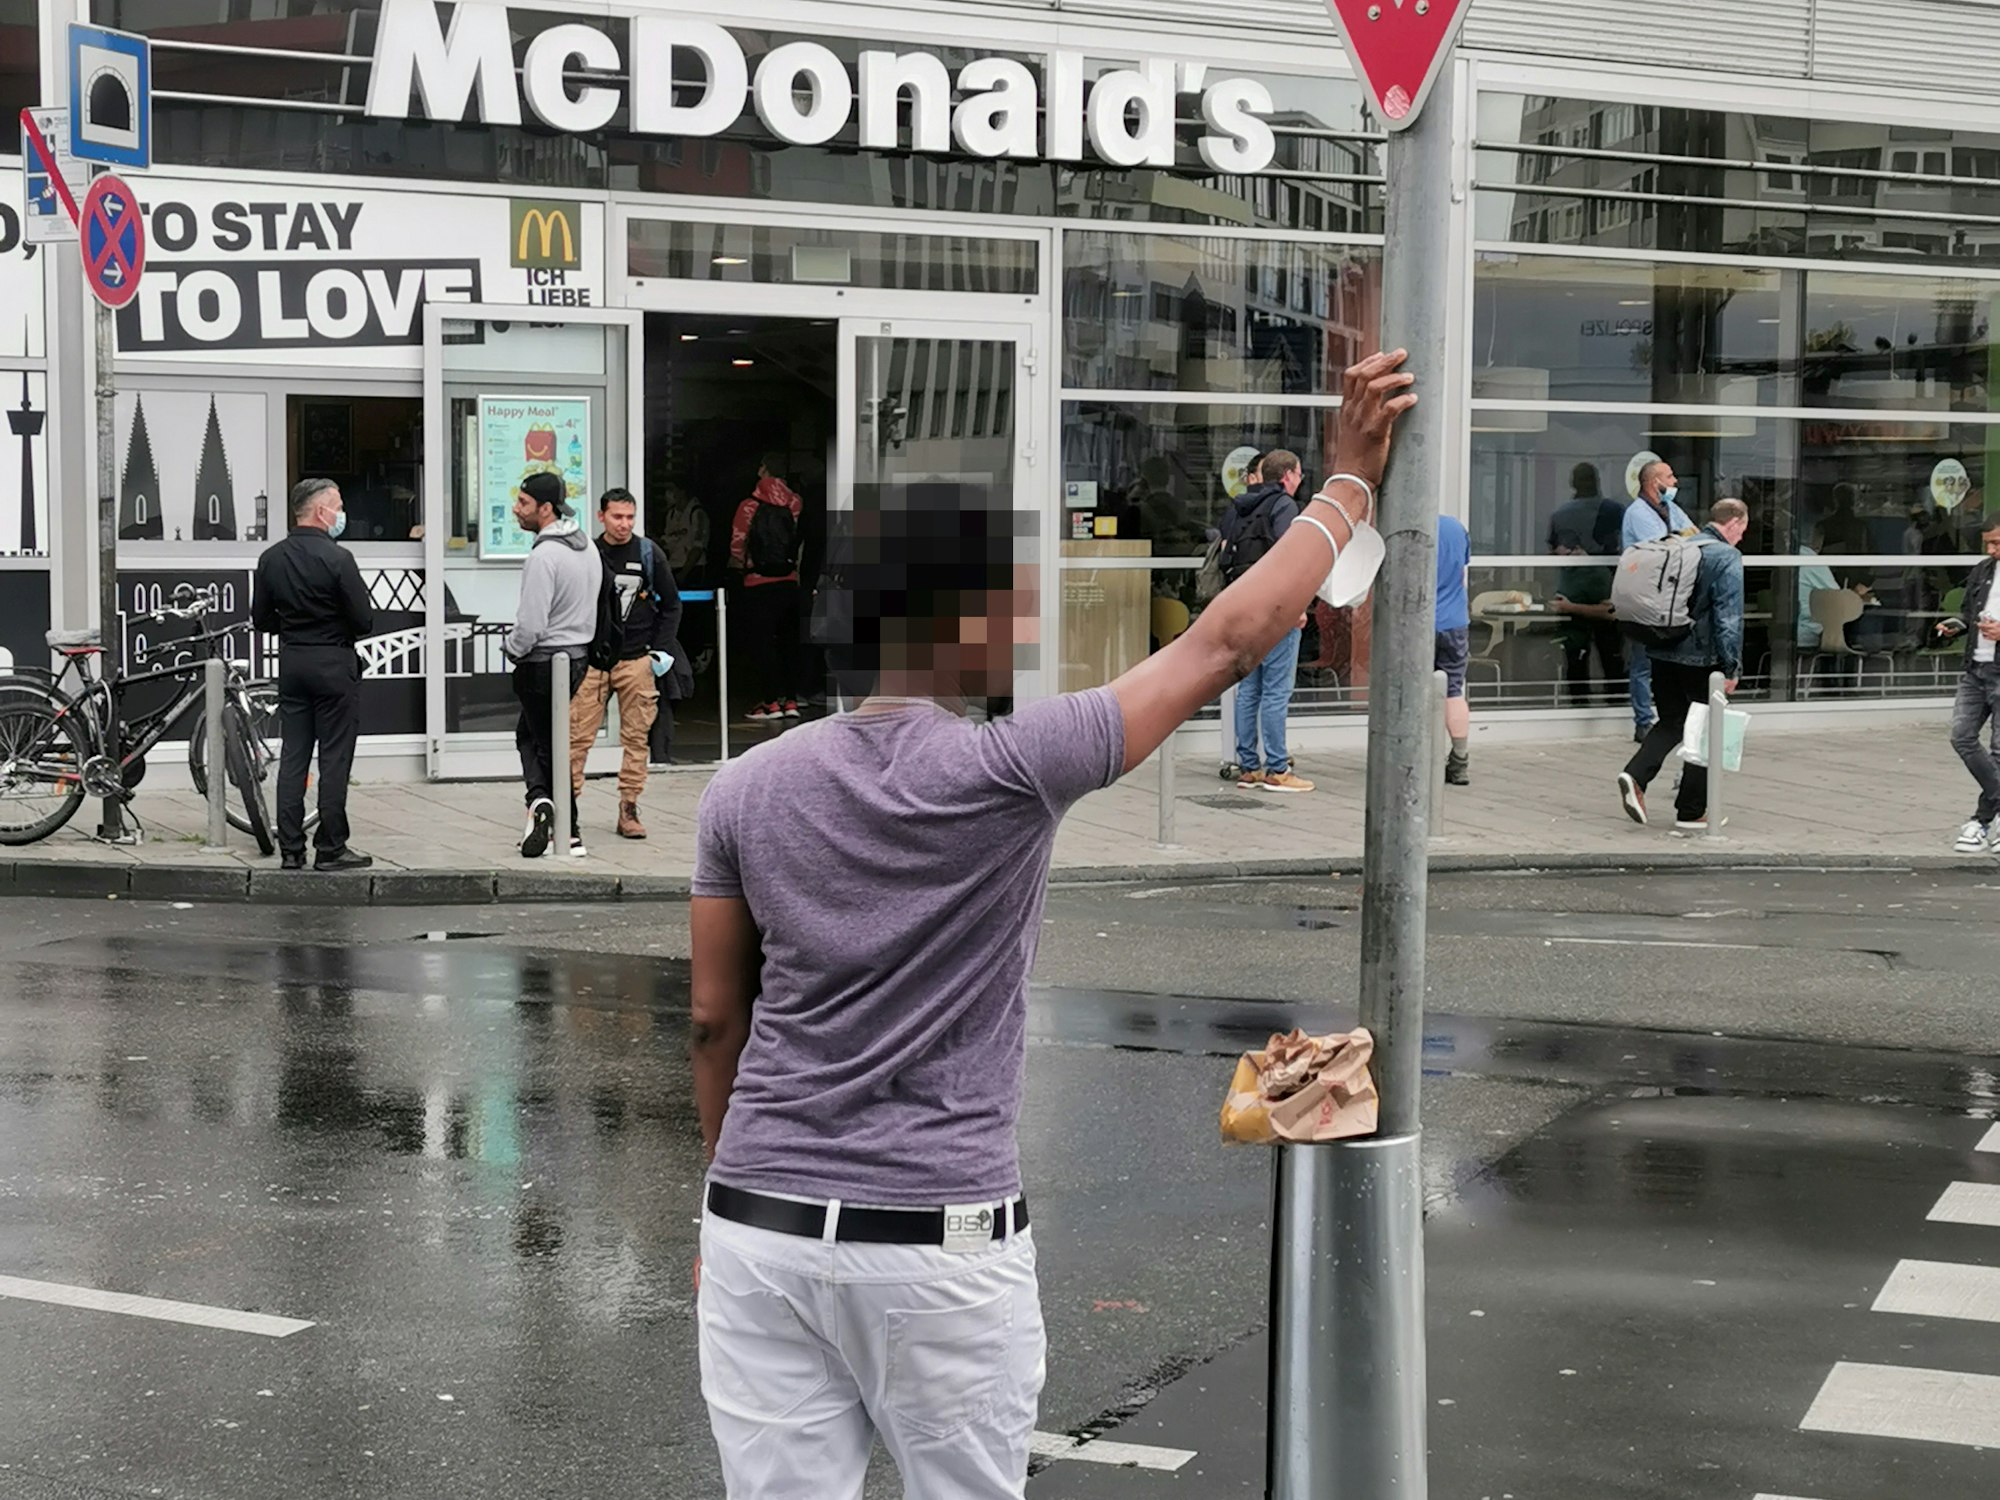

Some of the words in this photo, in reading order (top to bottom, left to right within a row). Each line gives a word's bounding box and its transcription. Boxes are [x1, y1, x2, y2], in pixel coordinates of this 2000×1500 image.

[364, 0, 1276, 174] McDonald's
[211, 201, 363, 252] STAY
[526, 267, 566, 286] ICH
[136, 269, 242, 342] TO
[528, 288, 591, 307] LIEBE
[487, 405, 525, 419] Happy
